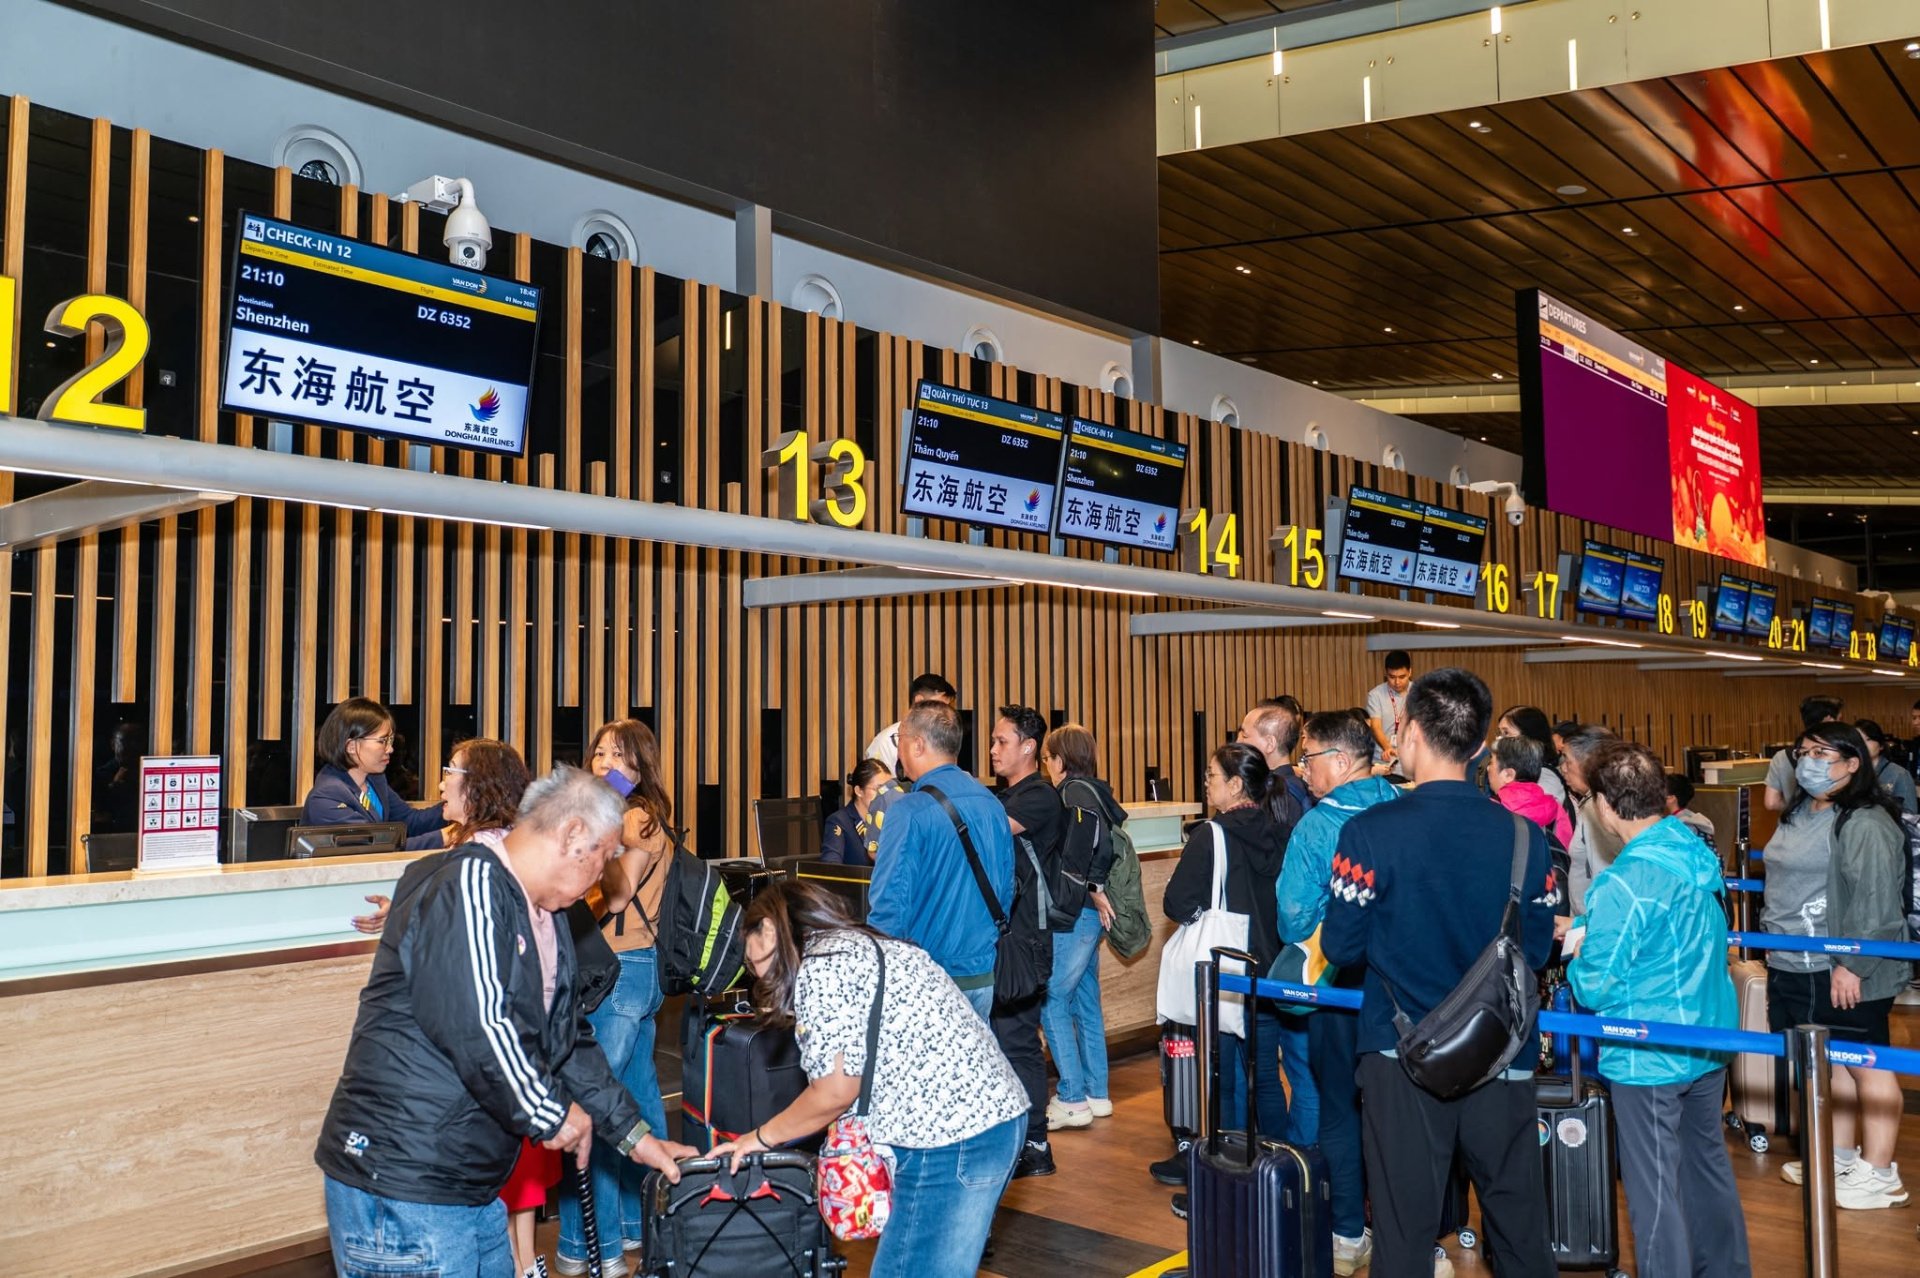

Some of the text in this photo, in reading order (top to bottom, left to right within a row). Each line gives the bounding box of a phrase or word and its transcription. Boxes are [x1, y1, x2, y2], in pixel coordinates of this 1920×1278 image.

[245, 243, 288, 259] Departure Time
[266, 228, 352, 259] CHECK-IN 12
[241, 265, 284, 287] 21:10
[313, 260, 353, 275] Estimated Time
[420, 286, 434, 295] Flight
[452, 277, 478, 289] VAN DON
[519, 288, 537, 298] 18:42
[238, 295, 274, 309] Destination
[512, 297, 522, 305] Nov
[236, 306, 310, 334] Shenzhen
[417, 305, 471, 329] DZ 6352
[1548, 303, 1587, 334] DEPARTURES
[239, 347, 435, 424] 东海航空
[931, 388, 951, 400] QUẦY
[967, 398, 980, 410] TỤC
[981, 401, 989, 410] 13
[464, 422, 498, 437] 东海航空
[917, 415, 939, 429] 21:10
[1081, 425, 1114, 439] CHECK-IN 14
[445, 429, 515, 447] DONGHAI AIRLINES
[1001, 434, 1029, 449] DZ 6352
[914, 443, 959, 461] Thâm Quyến
[1070, 448, 1087, 460] 21:10
[780, 431, 867, 527] 13
[1135, 463, 1144, 473] DZ
[1066, 473, 1095, 486] Shenzhen
[912, 470, 1008, 515] 东海航空
[1065, 497, 1141, 537] 东海航空
[1190, 507, 1240, 578] 14
[1283, 525, 1325, 589] 15
[1343, 547, 1393, 576] 东海航空
[1416, 560, 1459, 587] 东海航空
[1481, 561, 1509, 613] 16
[1534, 571, 1559, 619] 17
[1657, 593, 1674, 634] 18
[1688, 599, 1707, 638] 19
[1768, 615, 1782, 649] 20
[1792, 618, 1806, 652] 21
[1850, 630, 1860, 659] 22
[1866, 632, 1876, 661] 23
[1282, 988, 1309, 998] VAN DON
[1602, 1024, 1618, 1033] VAN
[1619, 1026, 1637, 1035] DON
[1841, 1052, 1862, 1060] DON
